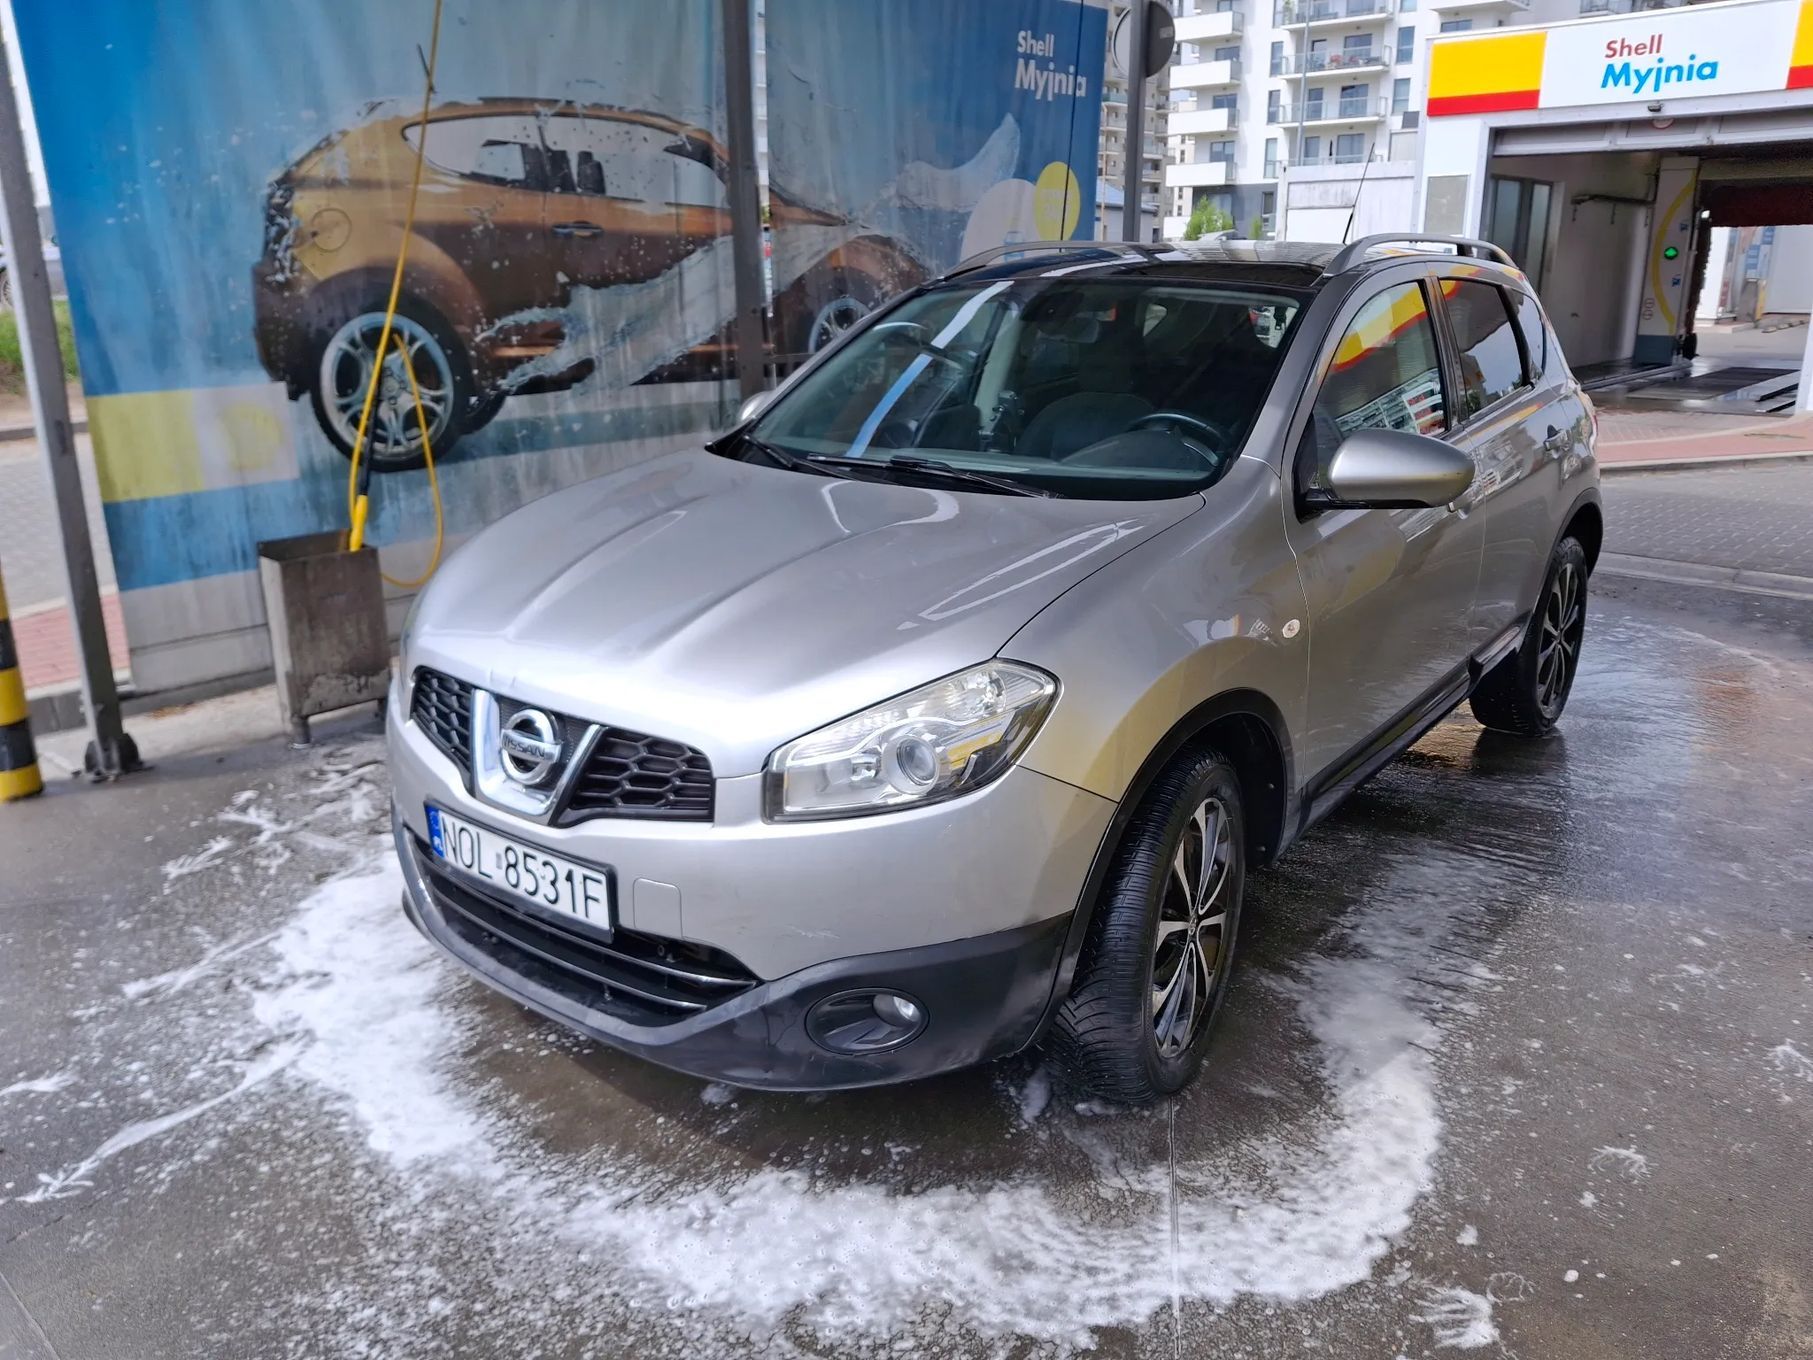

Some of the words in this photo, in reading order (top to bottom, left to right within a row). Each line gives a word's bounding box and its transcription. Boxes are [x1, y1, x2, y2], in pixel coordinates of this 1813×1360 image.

[1017, 30, 1055, 57] Shell
[1604, 34, 1663, 58] Shell
[1014, 58, 1087, 101] Myjnia
[1600, 54, 1719, 94] Myjnia
[502, 735, 545, 758] NISSAN
[442, 816, 493, 879] NOL
[504, 845, 604, 919] 8531F
